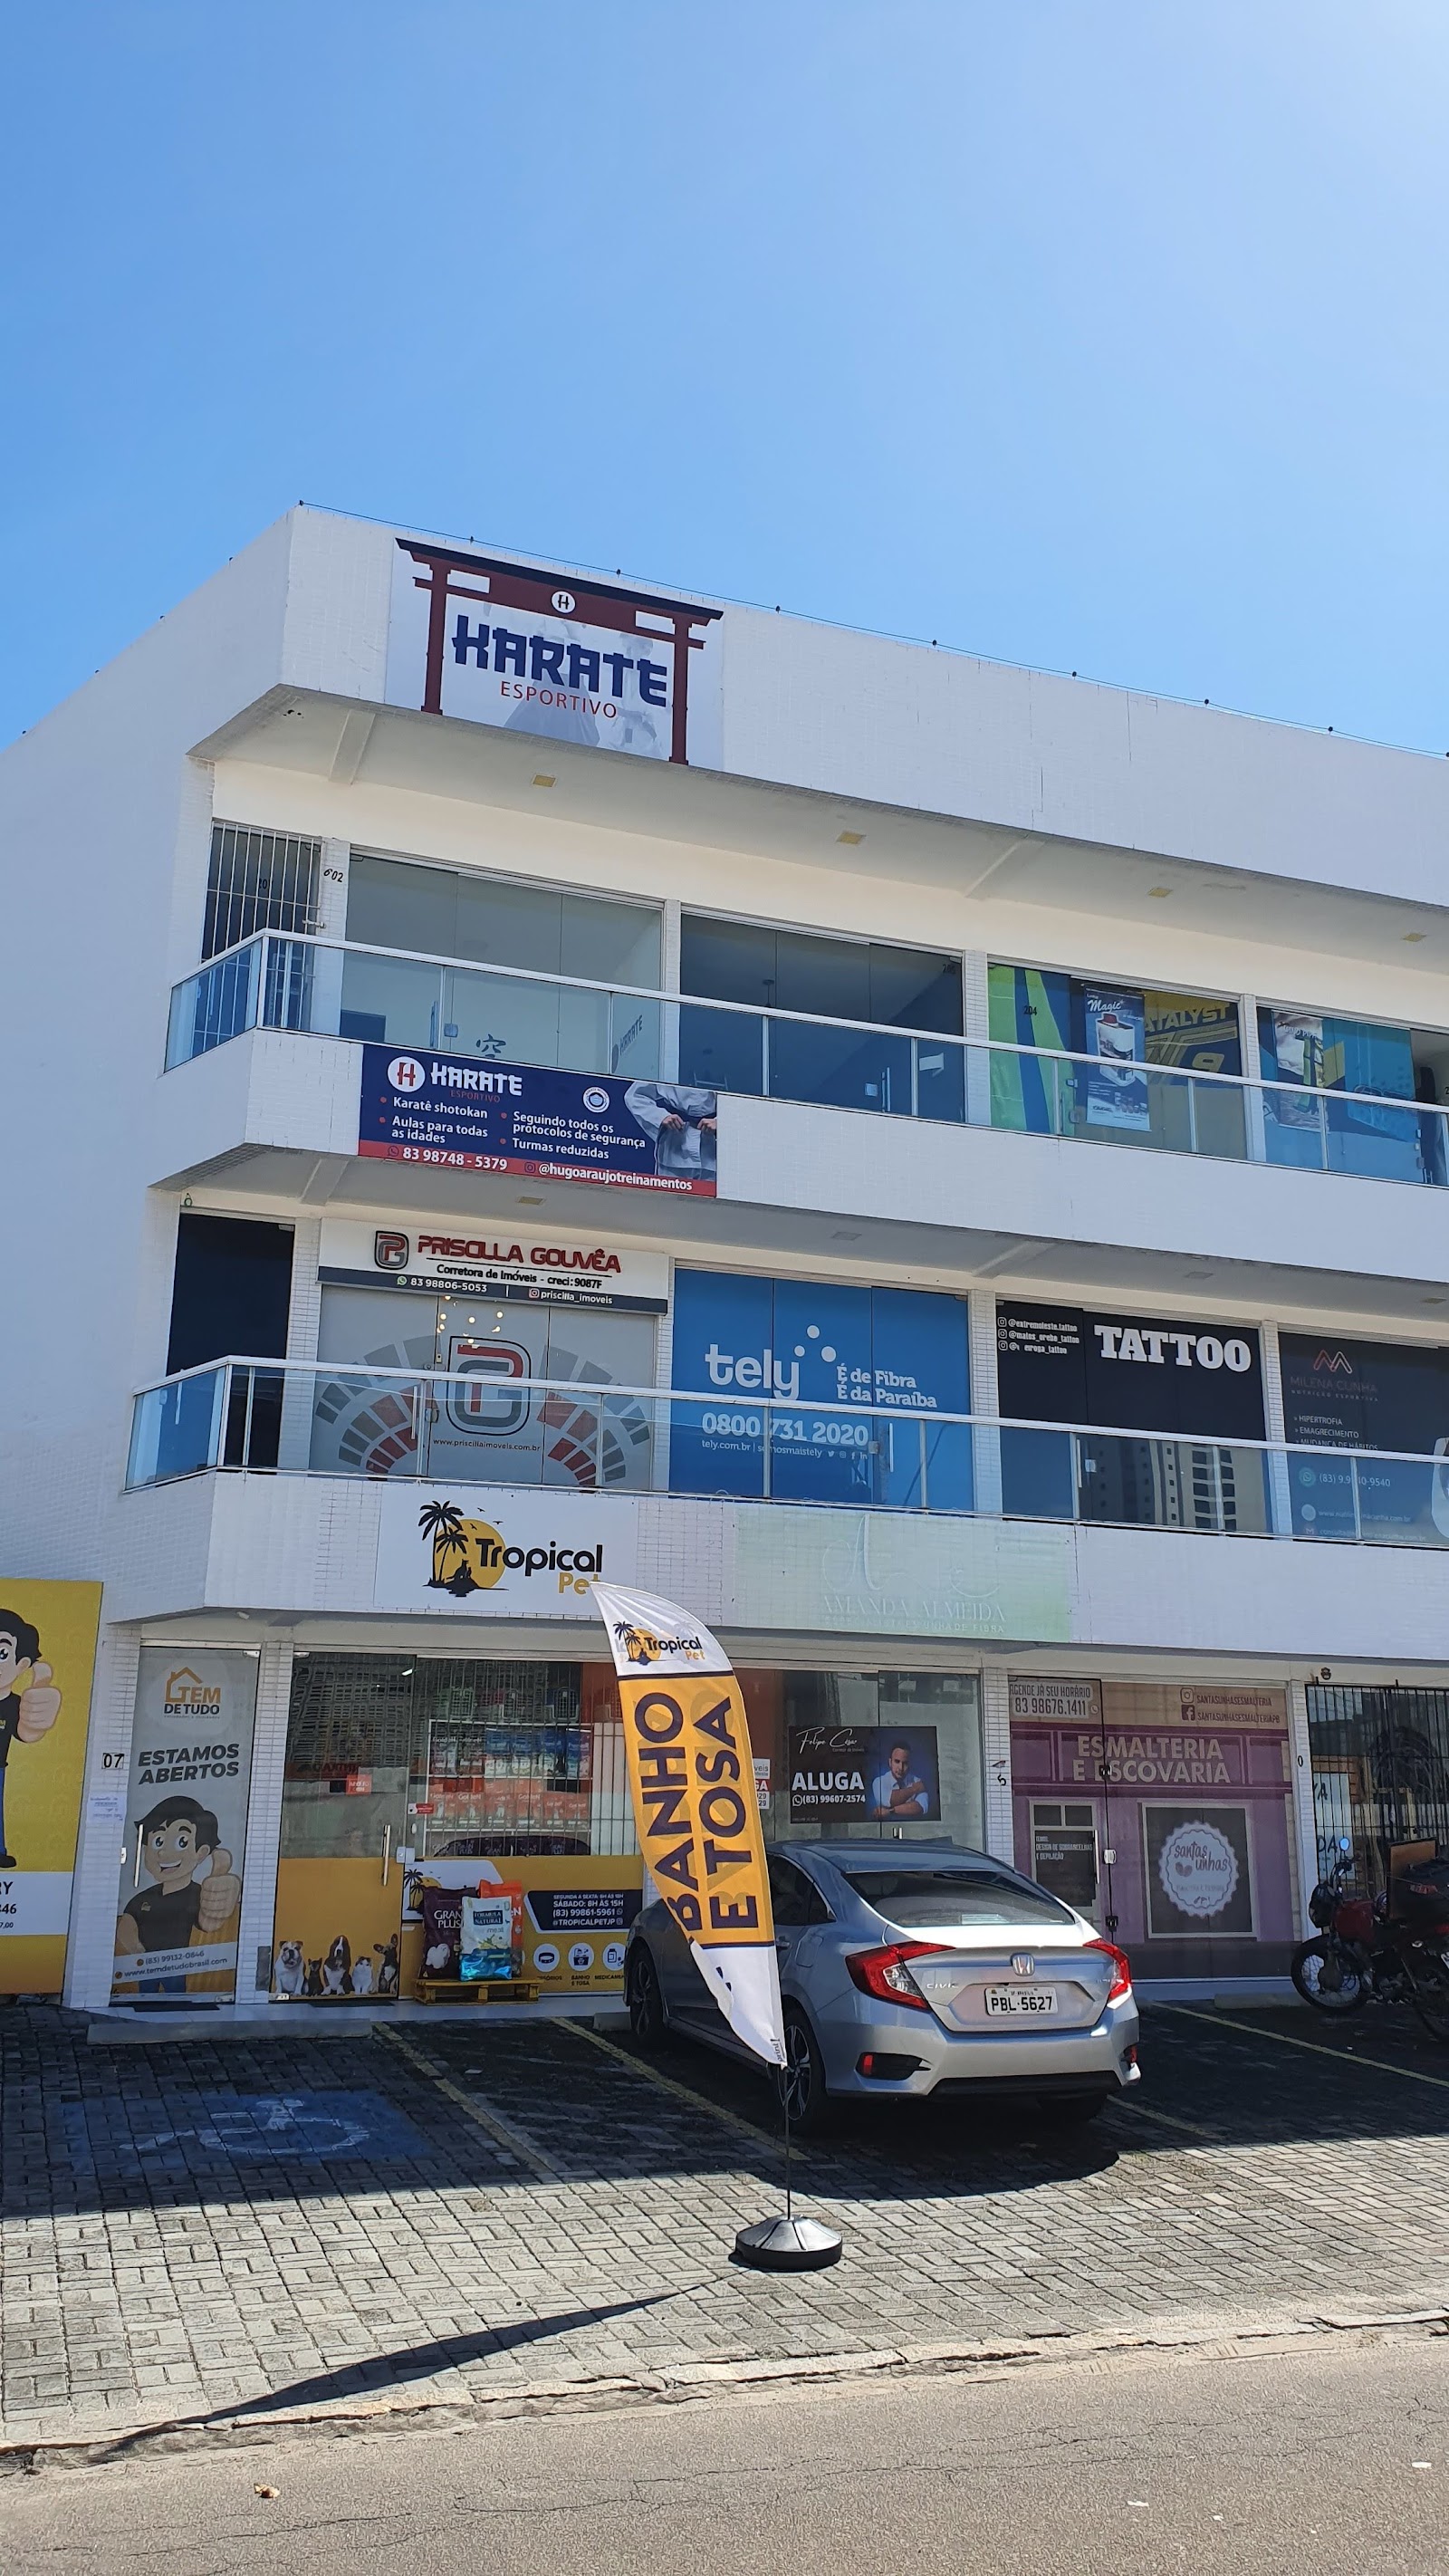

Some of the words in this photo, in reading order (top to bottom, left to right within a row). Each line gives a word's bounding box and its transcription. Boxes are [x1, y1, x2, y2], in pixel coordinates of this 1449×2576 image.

[452, 614, 667, 707] KARATE
[500, 680, 618, 719] ESPORTIVO
[323, 868, 344, 883] 602
[1023, 1005, 1038, 1016] 204
[1087, 999, 1123, 1014] Magic
[619, 1014, 643, 1056] KARATE
[430, 1062, 523, 1096] KARATE
[450, 1090, 501, 1103] ESPORTIVO
[393, 1096, 432, 1111] Karatê
[434, 1101, 488, 1119] shotokan
[392, 1115, 425, 1129] Aulas
[427, 1122, 454, 1134] para
[456, 1124, 488, 1138] todas
[513, 1110, 566, 1128] Seguindo
[568, 1118, 600, 1133] todos
[601, 1124, 614, 1134] os
[391, 1129, 405, 1139] as
[407, 1129, 446, 1144] idades
[513, 1122, 572, 1139] protocolos
[574, 1129, 589, 1141] de
[590, 1133, 646, 1149] segurança
[402, 1147, 419, 1160] 83
[423, 1150, 465, 1166] 98748
[475, 1155, 508, 1170] 5379
[512, 1138, 554, 1153] Turmas
[556, 1144, 609, 1159] reduzidas
[538, 1162, 693, 1191] @hugoaraujotreinamentos
[417, 1235, 524, 1264] PRISCILLA
[530, 1246, 622, 1274] GOUVÊA
[437, 1264, 484, 1279] Corretora
[485, 1268, 498, 1280] de
[500, 1269, 537, 1283] Imóveis
[410, 1277, 424, 1287] 83
[426, 1278, 487, 1293] 98806-5053
[541, 1290, 613, 1305] priscilla_imoveis
[1093, 1323, 1252, 1373] TATTOO
[705, 1343, 800, 1401] tely
[836, 1363, 848, 1382] É
[849, 1367, 872, 1384] de
[874, 1370, 916, 1389] Fibra
[836, 1380, 848, 1400] É
[849, 1386, 872, 1402] da
[702, 1412, 762, 1437] 0800
[811, 1421, 869, 1447] 2020
[1299, 1415, 1343, 1426] HIPERTROFIA
[1299, 1426, 1359, 1438] EMAGRECIMENTO
[433, 1438, 542, 1452] www.priscillaimoveis.com.br
[701, 1439, 752, 1452] tely.com.br
[1319, 1473, 1336, 1485] (83)
[475, 1537, 603, 1577] Tropical
[643, 1636, 703, 1654] Tropical
[685, 1650, 705, 1661] Pet
[177, 1687, 222, 1704] TEM
[1009, 1684, 1035, 1697] AGENDE
[1046, 1686, 1059, 1697] SEU
[1060, 1685, 1090, 1698] HORÁRIO
[164, 1703, 181, 1715] DE
[183, 1704, 220, 1716] TUDO
[1014, 1697, 1029, 1714] 83
[1032, 1697, 1086, 1716] 98676.1411
[796, 1726, 826, 1754] Felipe
[1077, 1735, 1224, 1760] ESMALTERIA
[103, 1753, 125, 1768] 07
[138, 1743, 240, 1767] ESTAMOS
[138, 1761, 240, 1785] ABERTOS
[792, 1771, 865, 1791] ALUGA
[1072, 1759, 1086, 1782] E
[1094, 1761, 1231, 1783] ESCOVARIA
[692, 1695, 753, 1875] TOSA
[802, 1794, 819, 1804] (83)
[820, 1794, 866, 1803] 99607-2574
[634, 1691, 703, 1932] BANHO
[1174, 1841, 1208, 1860] santas
[1195, 1850, 1228, 1871] unhas
[552, 1908, 569, 1918] (83)
[570, 1908, 616, 1917] 99861-5961
[553, 1899, 586, 1908] SÁBADO:
[711, 1895, 759, 1929] E
[433, 1909, 463, 1920] GRAN
[437, 1919, 462, 1929] PLUS
[552, 1918, 616, 1927] @TROPICALPETJP
[124, 1957, 227, 1978] www.temdetudobrasil.com
[145, 1956, 159, 1966] (83)
[161, 1949, 205, 1963] 99132-0846
